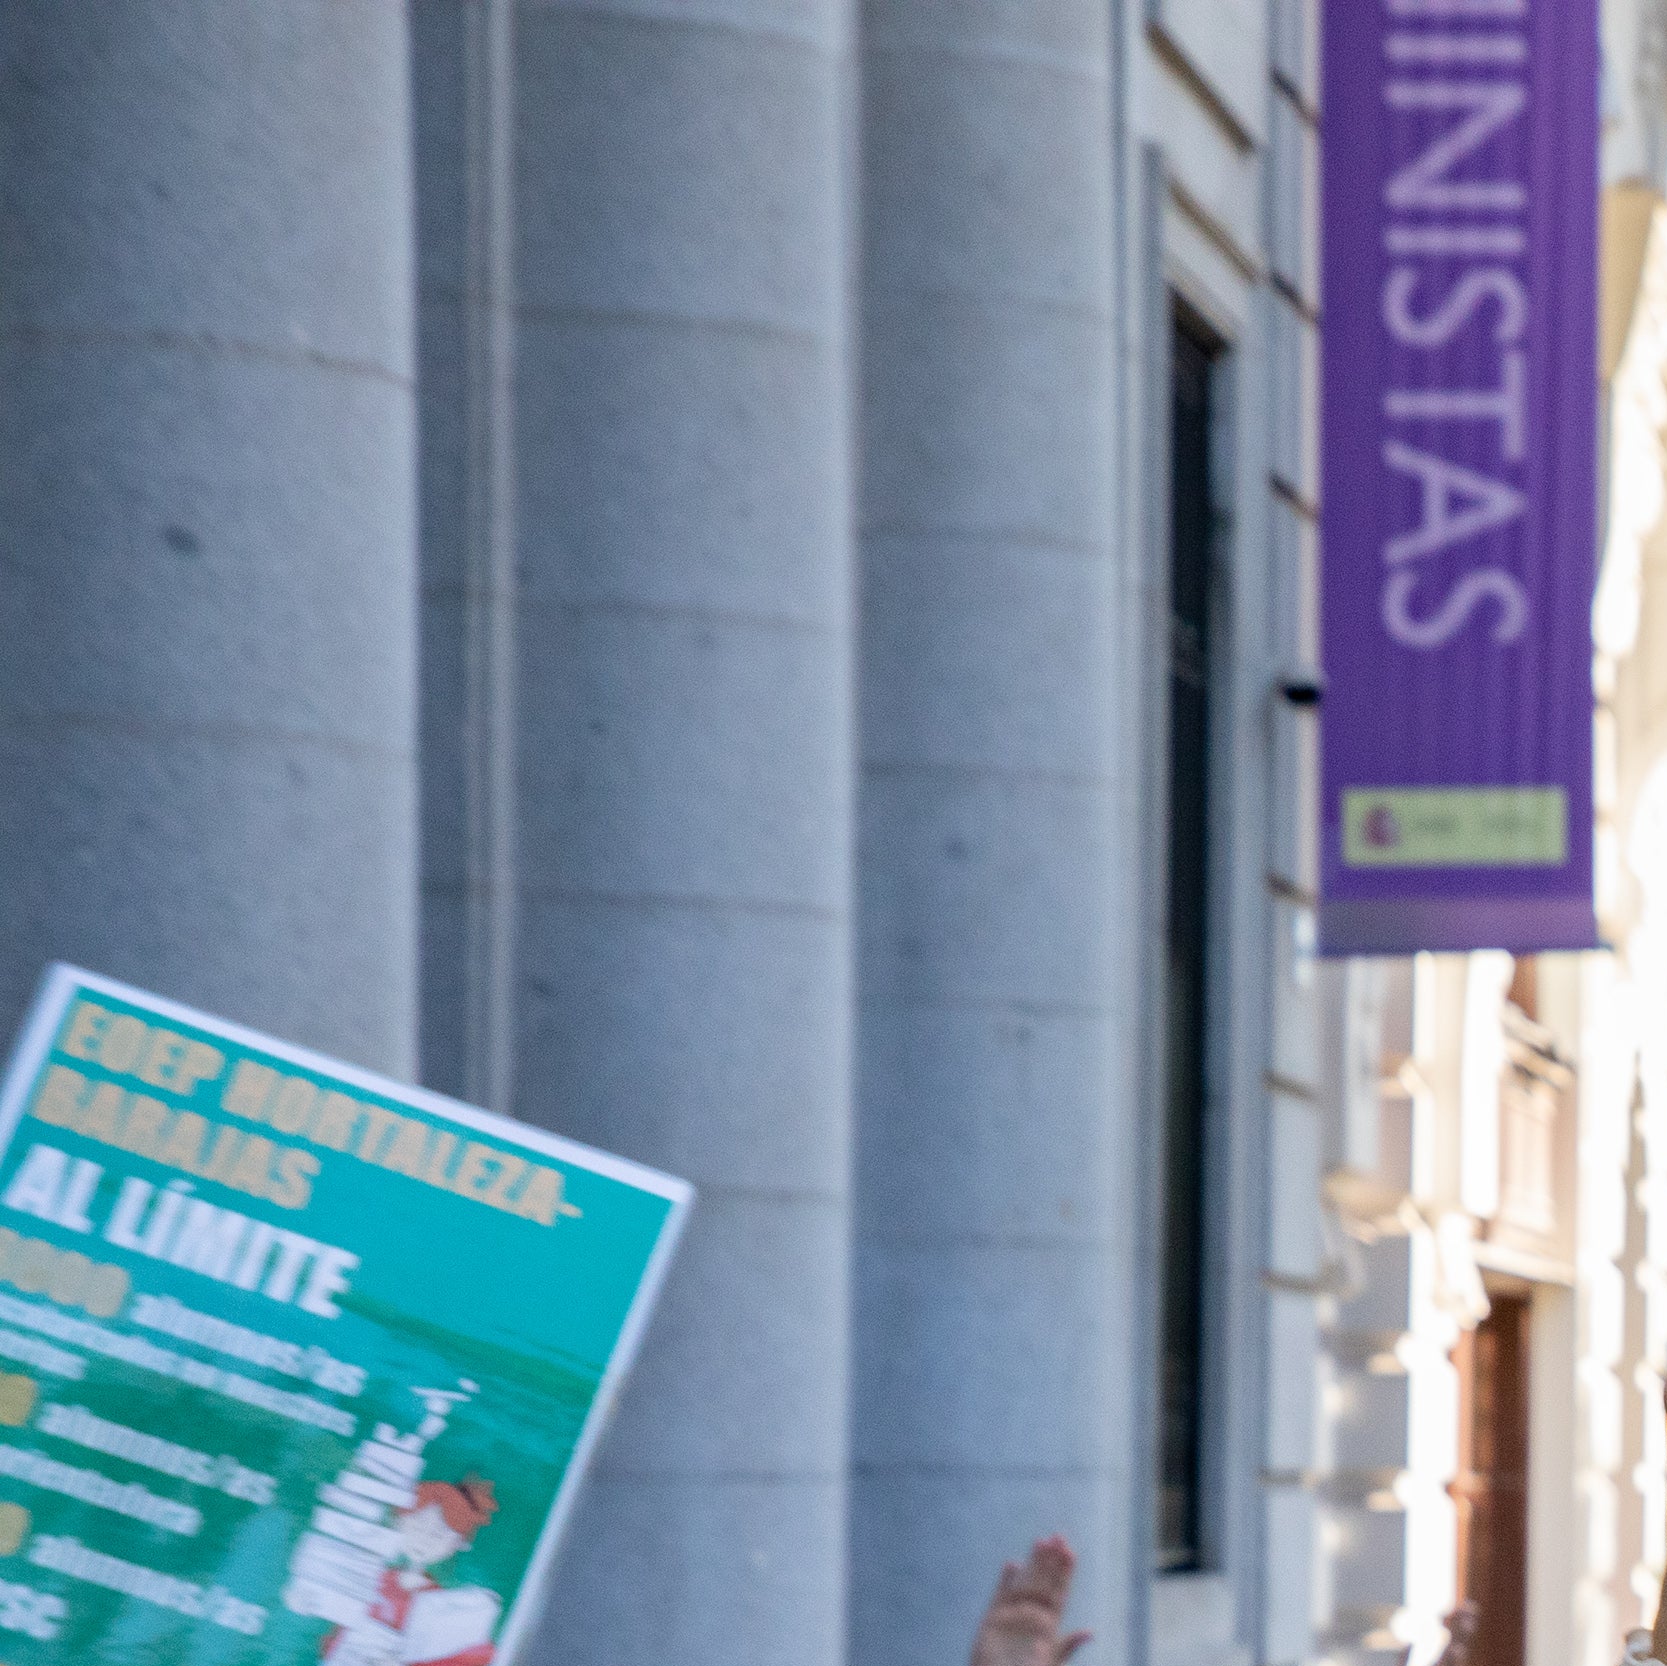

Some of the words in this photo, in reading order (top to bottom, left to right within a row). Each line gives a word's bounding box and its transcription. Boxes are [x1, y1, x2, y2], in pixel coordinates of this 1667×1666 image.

[1382, 0, 1527, 648] INISTAS
[33, 1064, 321, 1210] BARAJAS
[2, 1144, 105, 1234] AL
[102, 1176, 362, 1319] LÍMITE
